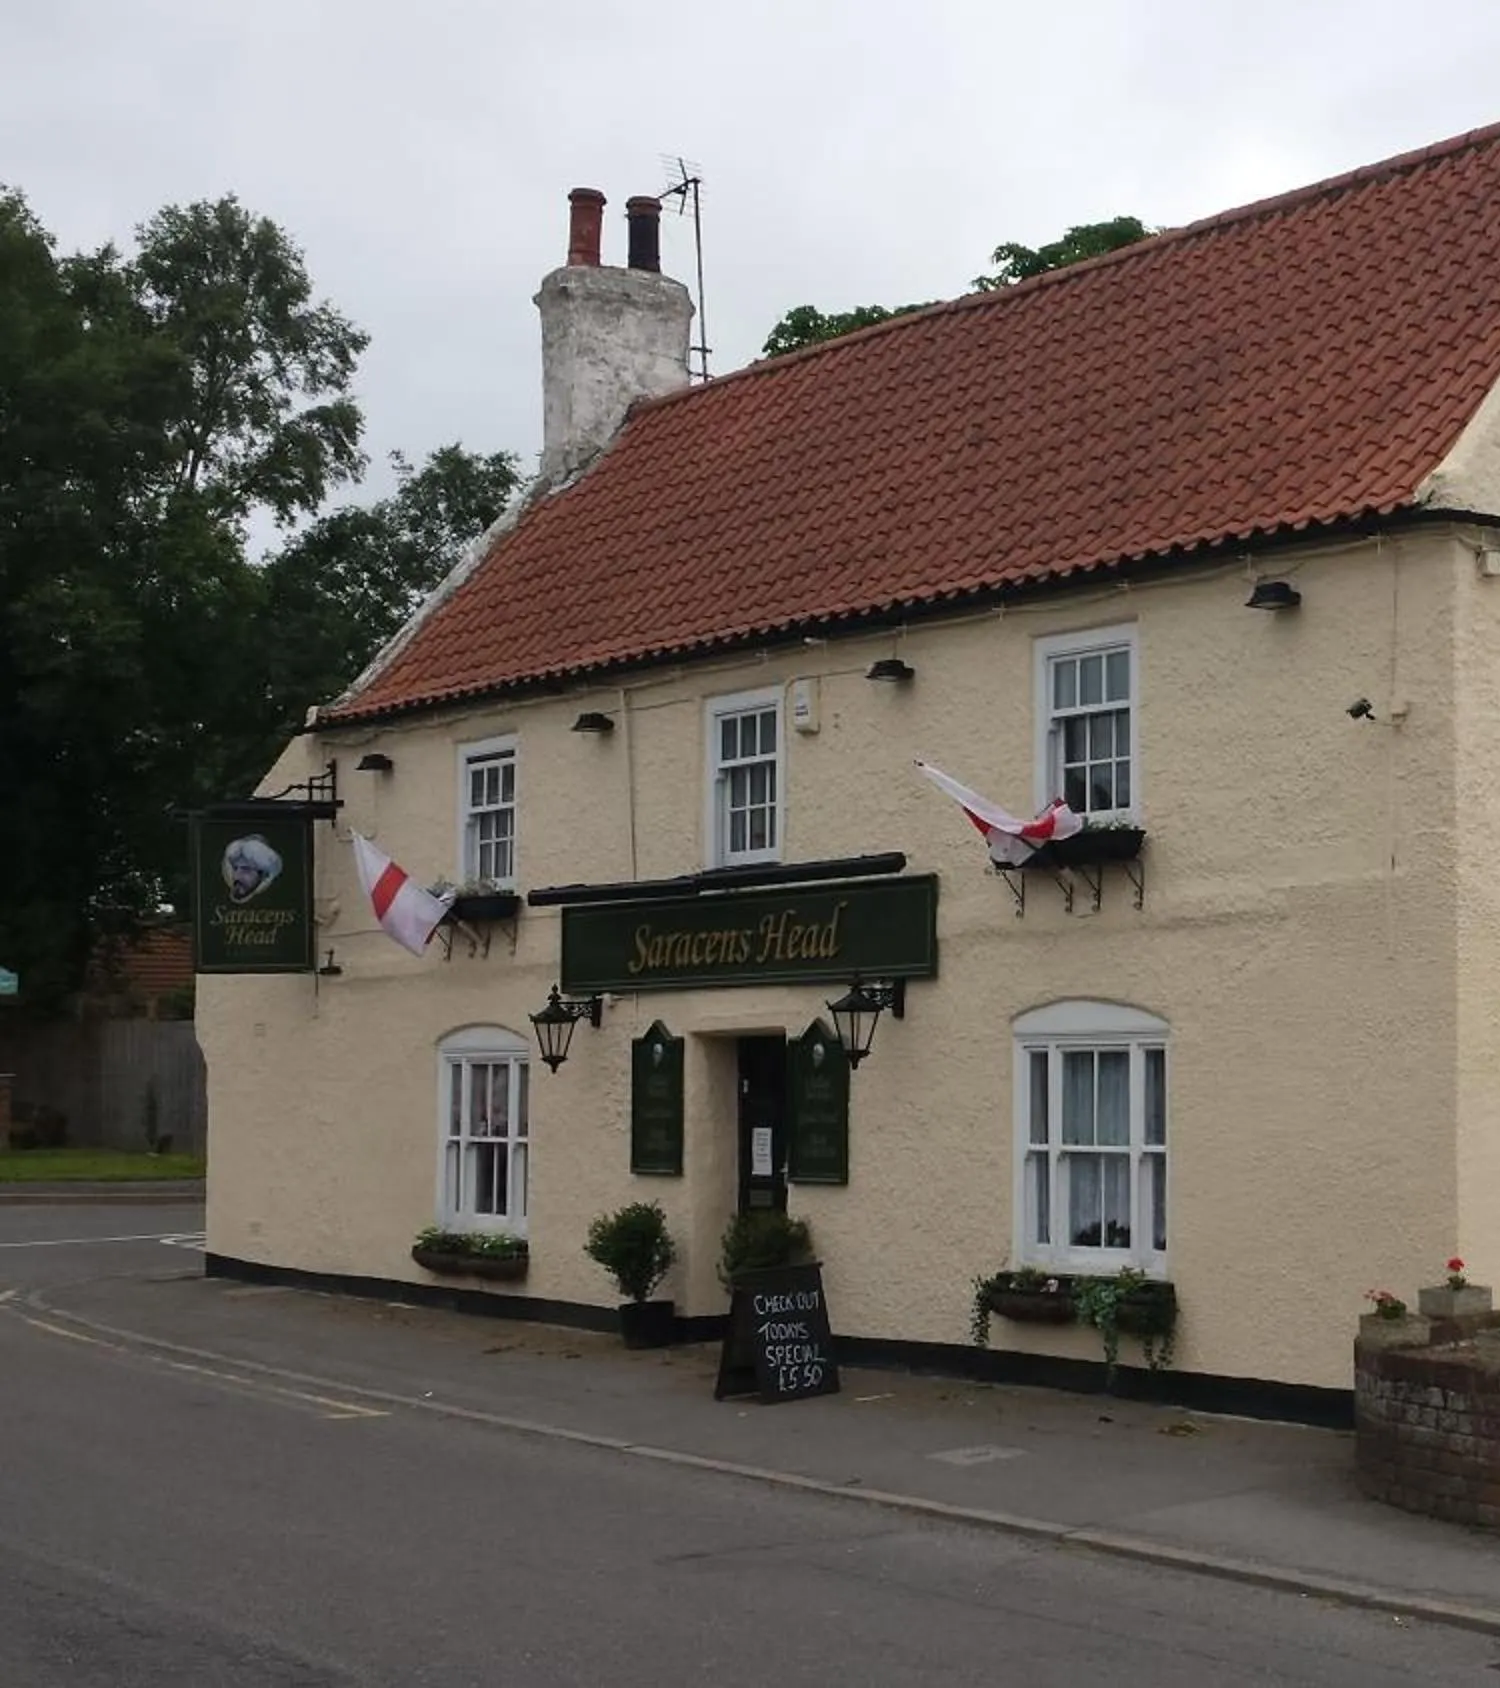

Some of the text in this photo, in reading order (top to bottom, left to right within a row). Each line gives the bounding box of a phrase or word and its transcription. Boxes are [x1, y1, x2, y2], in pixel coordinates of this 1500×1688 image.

[209, 904, 297, 927] Saracens
[224, 924, 280, 945] Head
[628, 901, 849, 974] Saracens Head
[753, 1290, 819, 1315] CHECK OUT
[758, 1321, 809, 1341] TODAYS
[765, 1343, 827, 1367] SPECIAL
